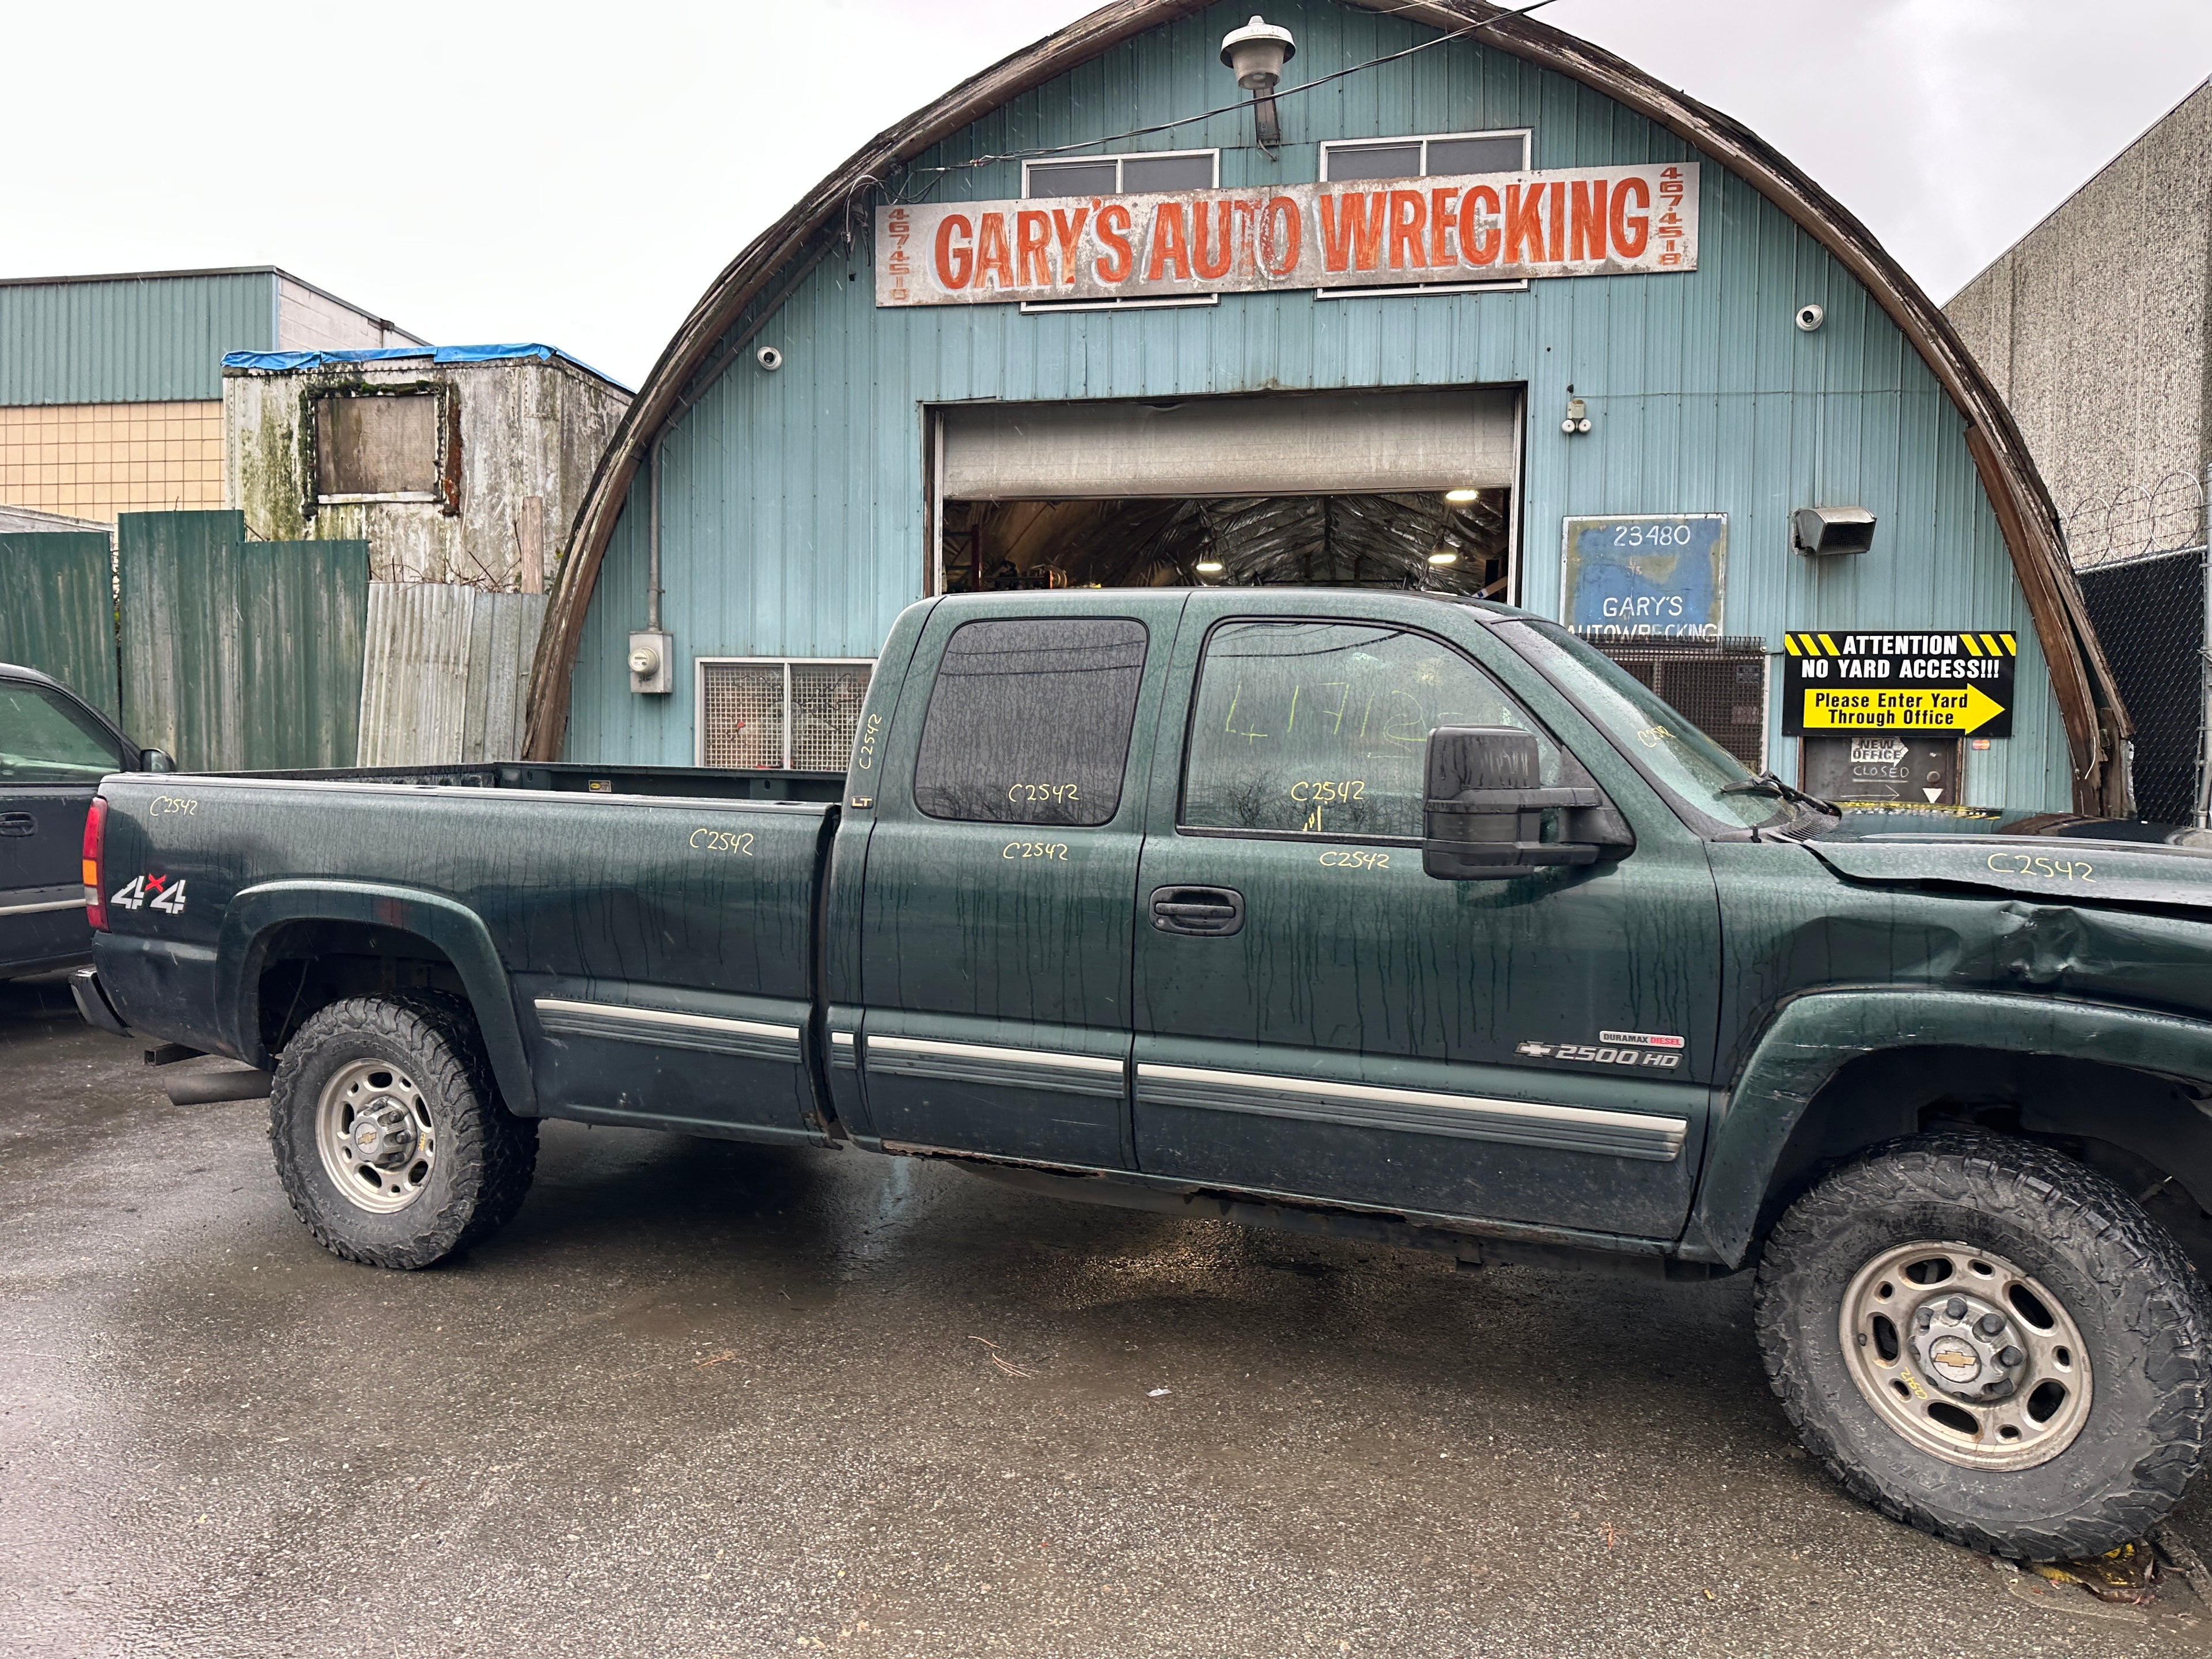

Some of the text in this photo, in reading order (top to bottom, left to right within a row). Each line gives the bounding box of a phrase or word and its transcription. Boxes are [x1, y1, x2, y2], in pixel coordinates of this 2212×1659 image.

[933, 176, 1650, 289] GARY'S AUTO WRECKING
[1613, 525, 1691, 547] 23480
[1603, 595, 1683, 617] GARY'S
[1843, 634, 1958, 656] ATTENTION
[1801, 659, 2000, 679] NO YARD ACCESS!!!
[1815, 692, 1968, 709] Please Enter Yard
[1828, 709, 1954, 726] Through Office
[859, 714, 882, 770] C2542
[1859, 738, 1894, 749] NEW
[1853, 748, 1901, 760] OFFICE
[1853, 766, 1909, 778] CLOSED
[851, 797, 873, 807] LT
[1008, 783, 1080, 804] C2542
[1290, 781, 1365, 803] C2542
[149, 796, 198, 816] C2542
[689, 828, 754, 857] C2542
[1002, 842, 1069, 861] C2542
[1319, 851, 1390, 870] C2542
[1987, 853, 2097, 882] C2542
[1603, 1033, 1681, 1046] DURAMAX DIESEL
[1555, 1045, 1679, 1067] 2500 HD
